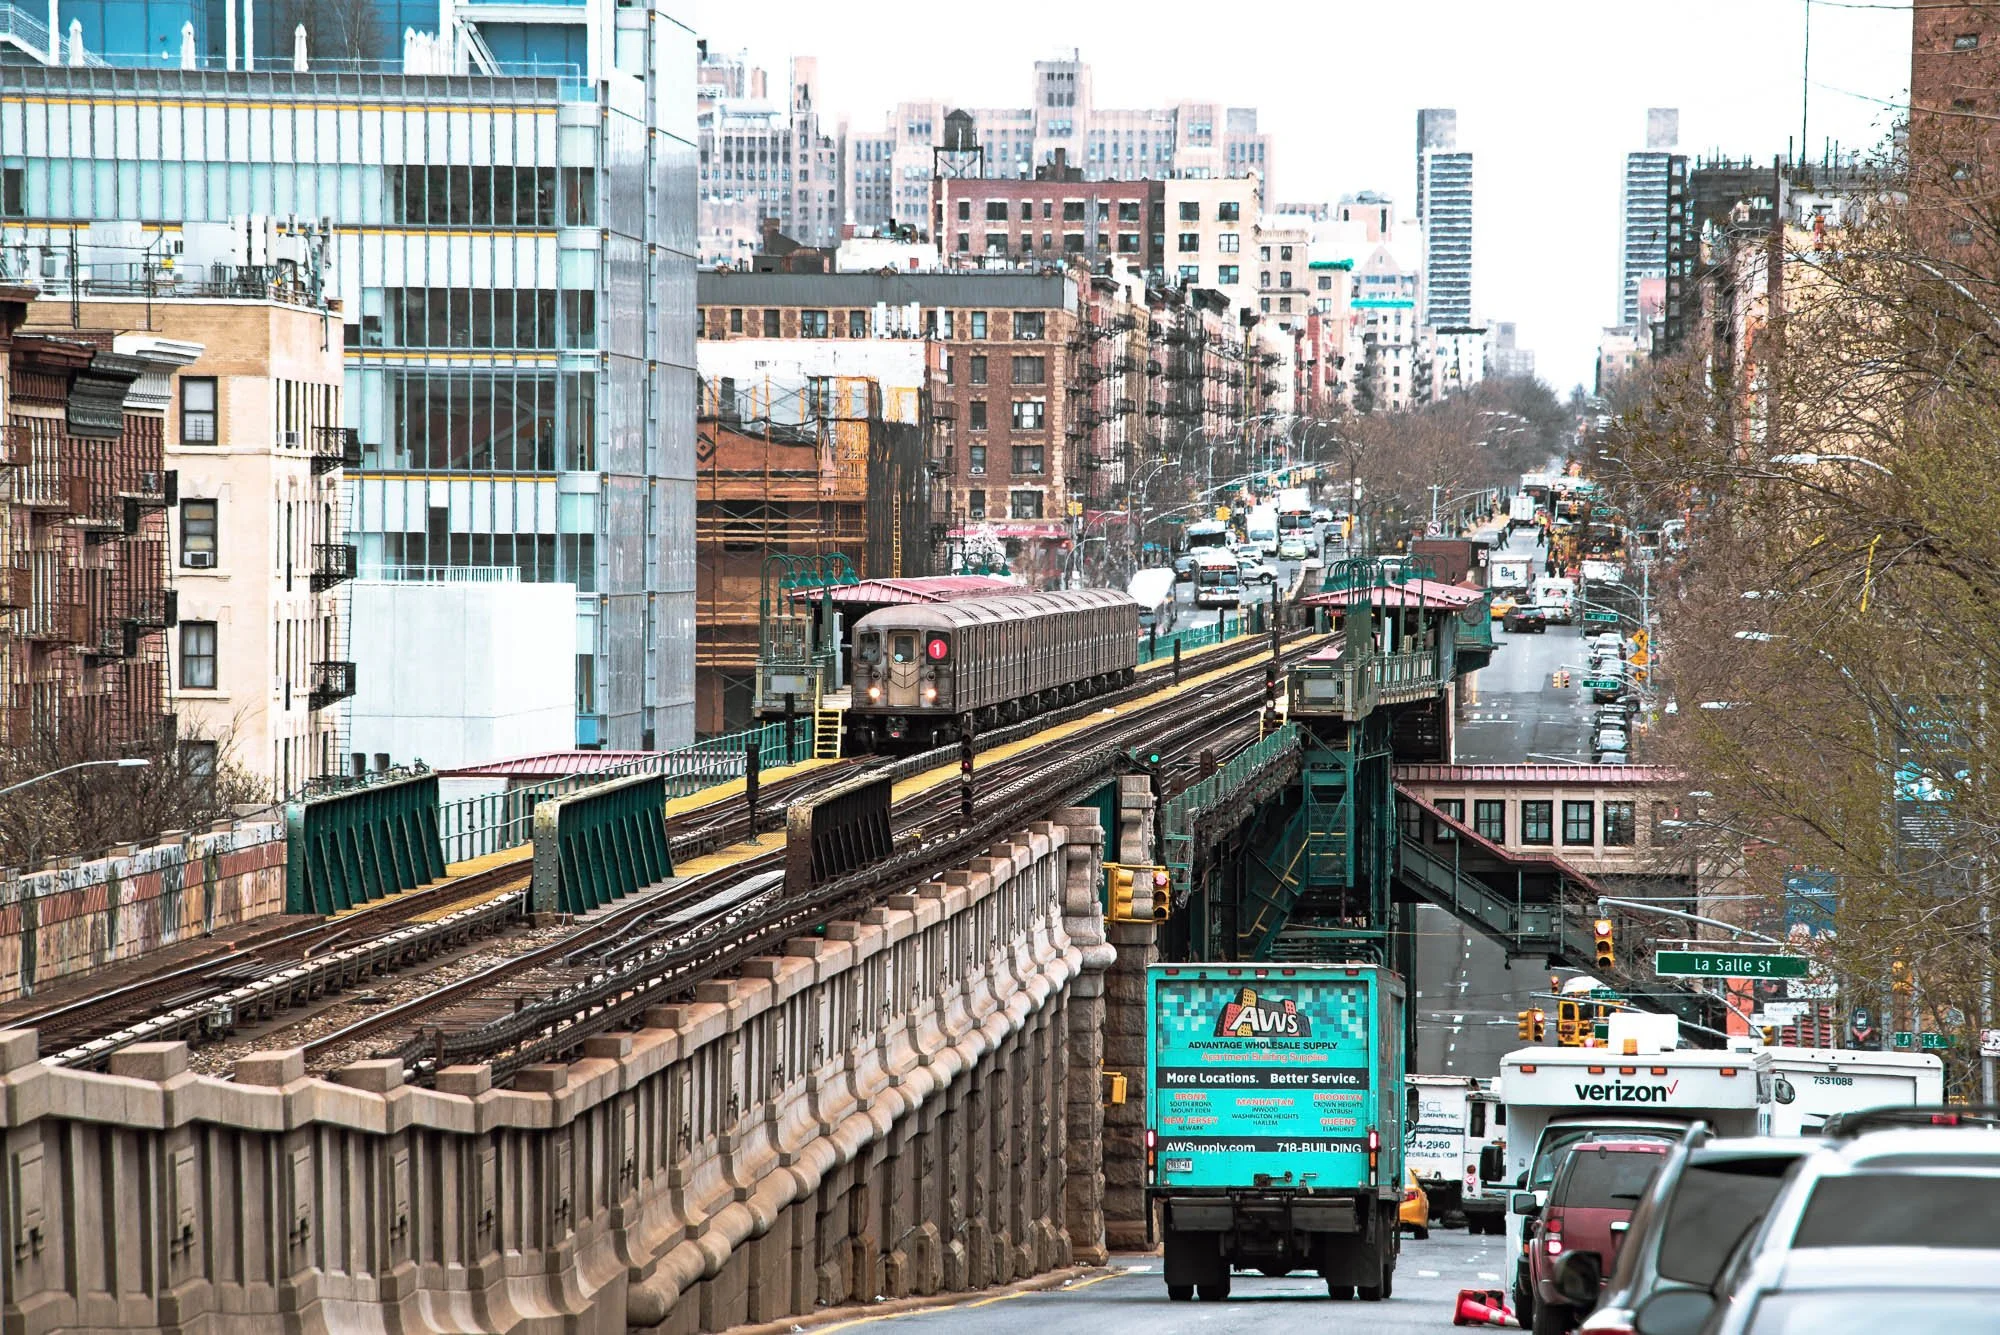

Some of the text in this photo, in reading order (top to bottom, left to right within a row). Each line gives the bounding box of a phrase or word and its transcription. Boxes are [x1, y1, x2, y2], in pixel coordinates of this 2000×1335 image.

[933, 643, 941, 657] 1
[1695, 958, 1772, 973] La Salle St
[1229, 1006, 1298, 1034] AWS
[1188, 1041, 1338, 1050] ADVANTAGE WHOLESALE SUPPLY
[1201, 1052, 1329, 1063] Apartment Building Supplies
[1167, 1072, 1259, 1084] More Locations.
[1270, 1073, 1360, 1084] Better Service.
[1813, 1076, 1853, 1086] 7531088
[1175, 1092, 1207, 1101] BRONX
[1575, 1080, 1667, 1102] verizon
[1236, 1098, 1294, 1106] MANHATTAN
[1313, 1093, 1363, 1101] BROOKLYN
[1163, 1116, 1218, 1124] NEW JERSEY
[1320, 1117, 1357, 1126] QUEENS
[1166, 1142, 1362, 1154] AWSupply.com 718-BUILDING
